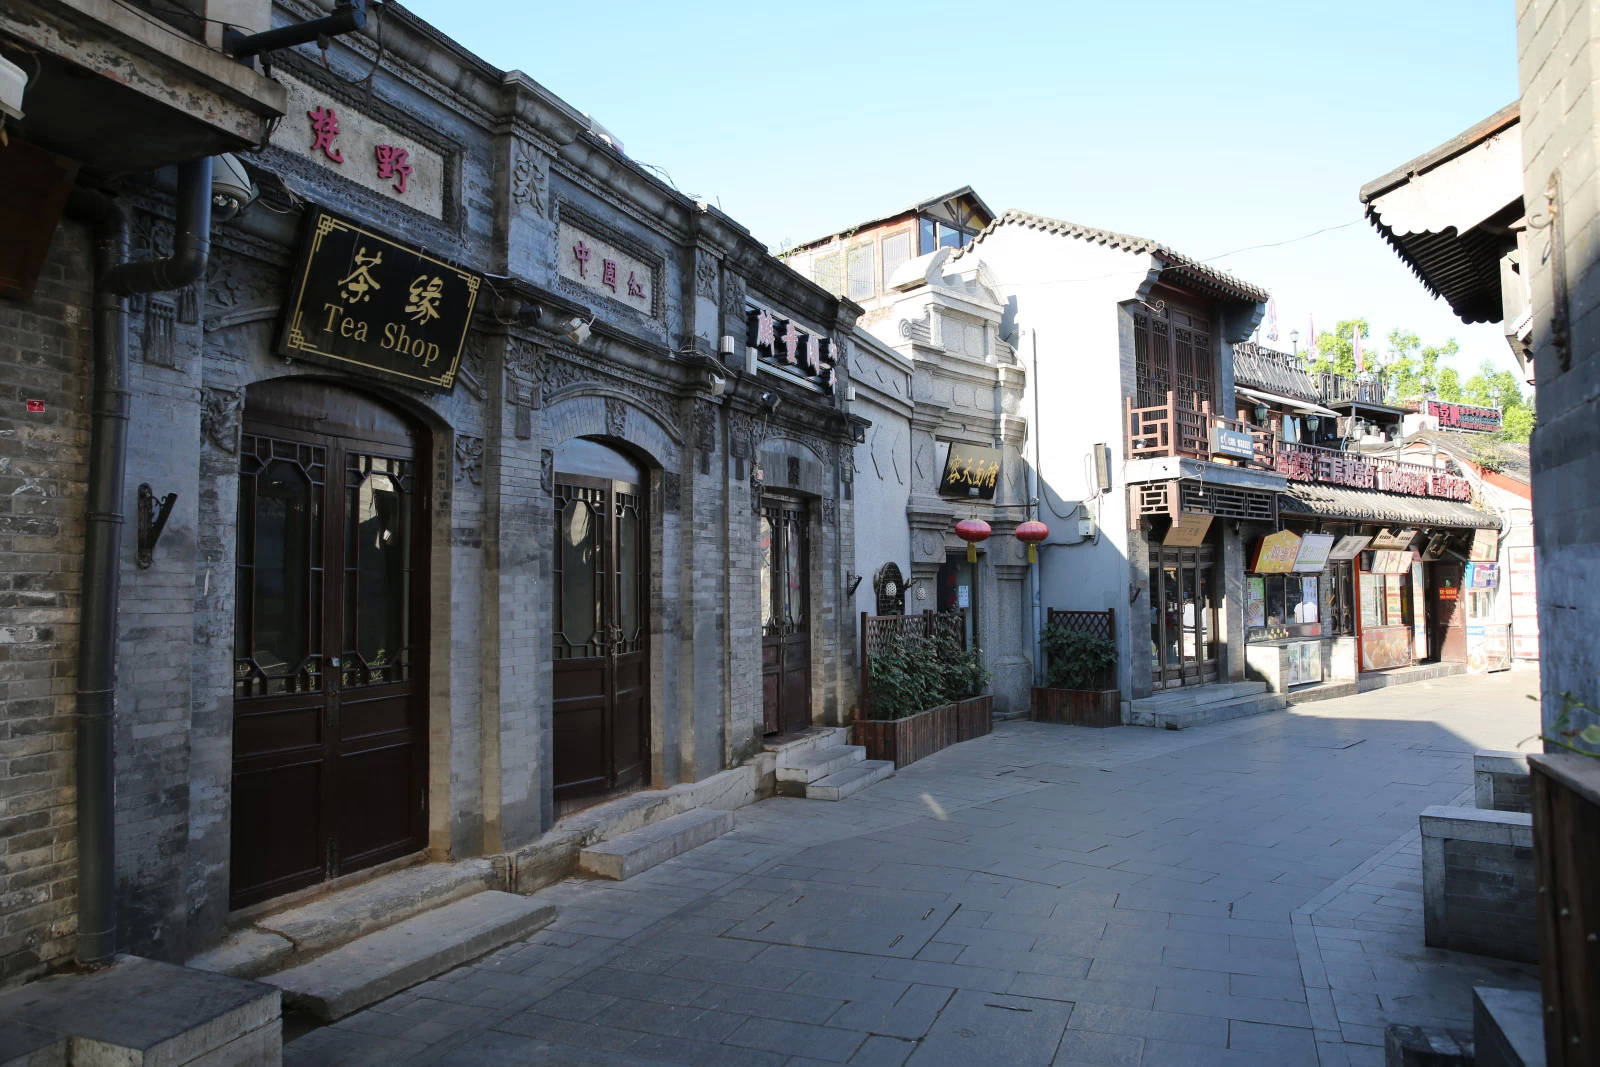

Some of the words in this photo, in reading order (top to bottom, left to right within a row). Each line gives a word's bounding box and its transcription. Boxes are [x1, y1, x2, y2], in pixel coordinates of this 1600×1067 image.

[307, 104, 413, 193] 梵野
[322, 302, 368, 342] Tea
[380, 321, 440, 368] Shop
